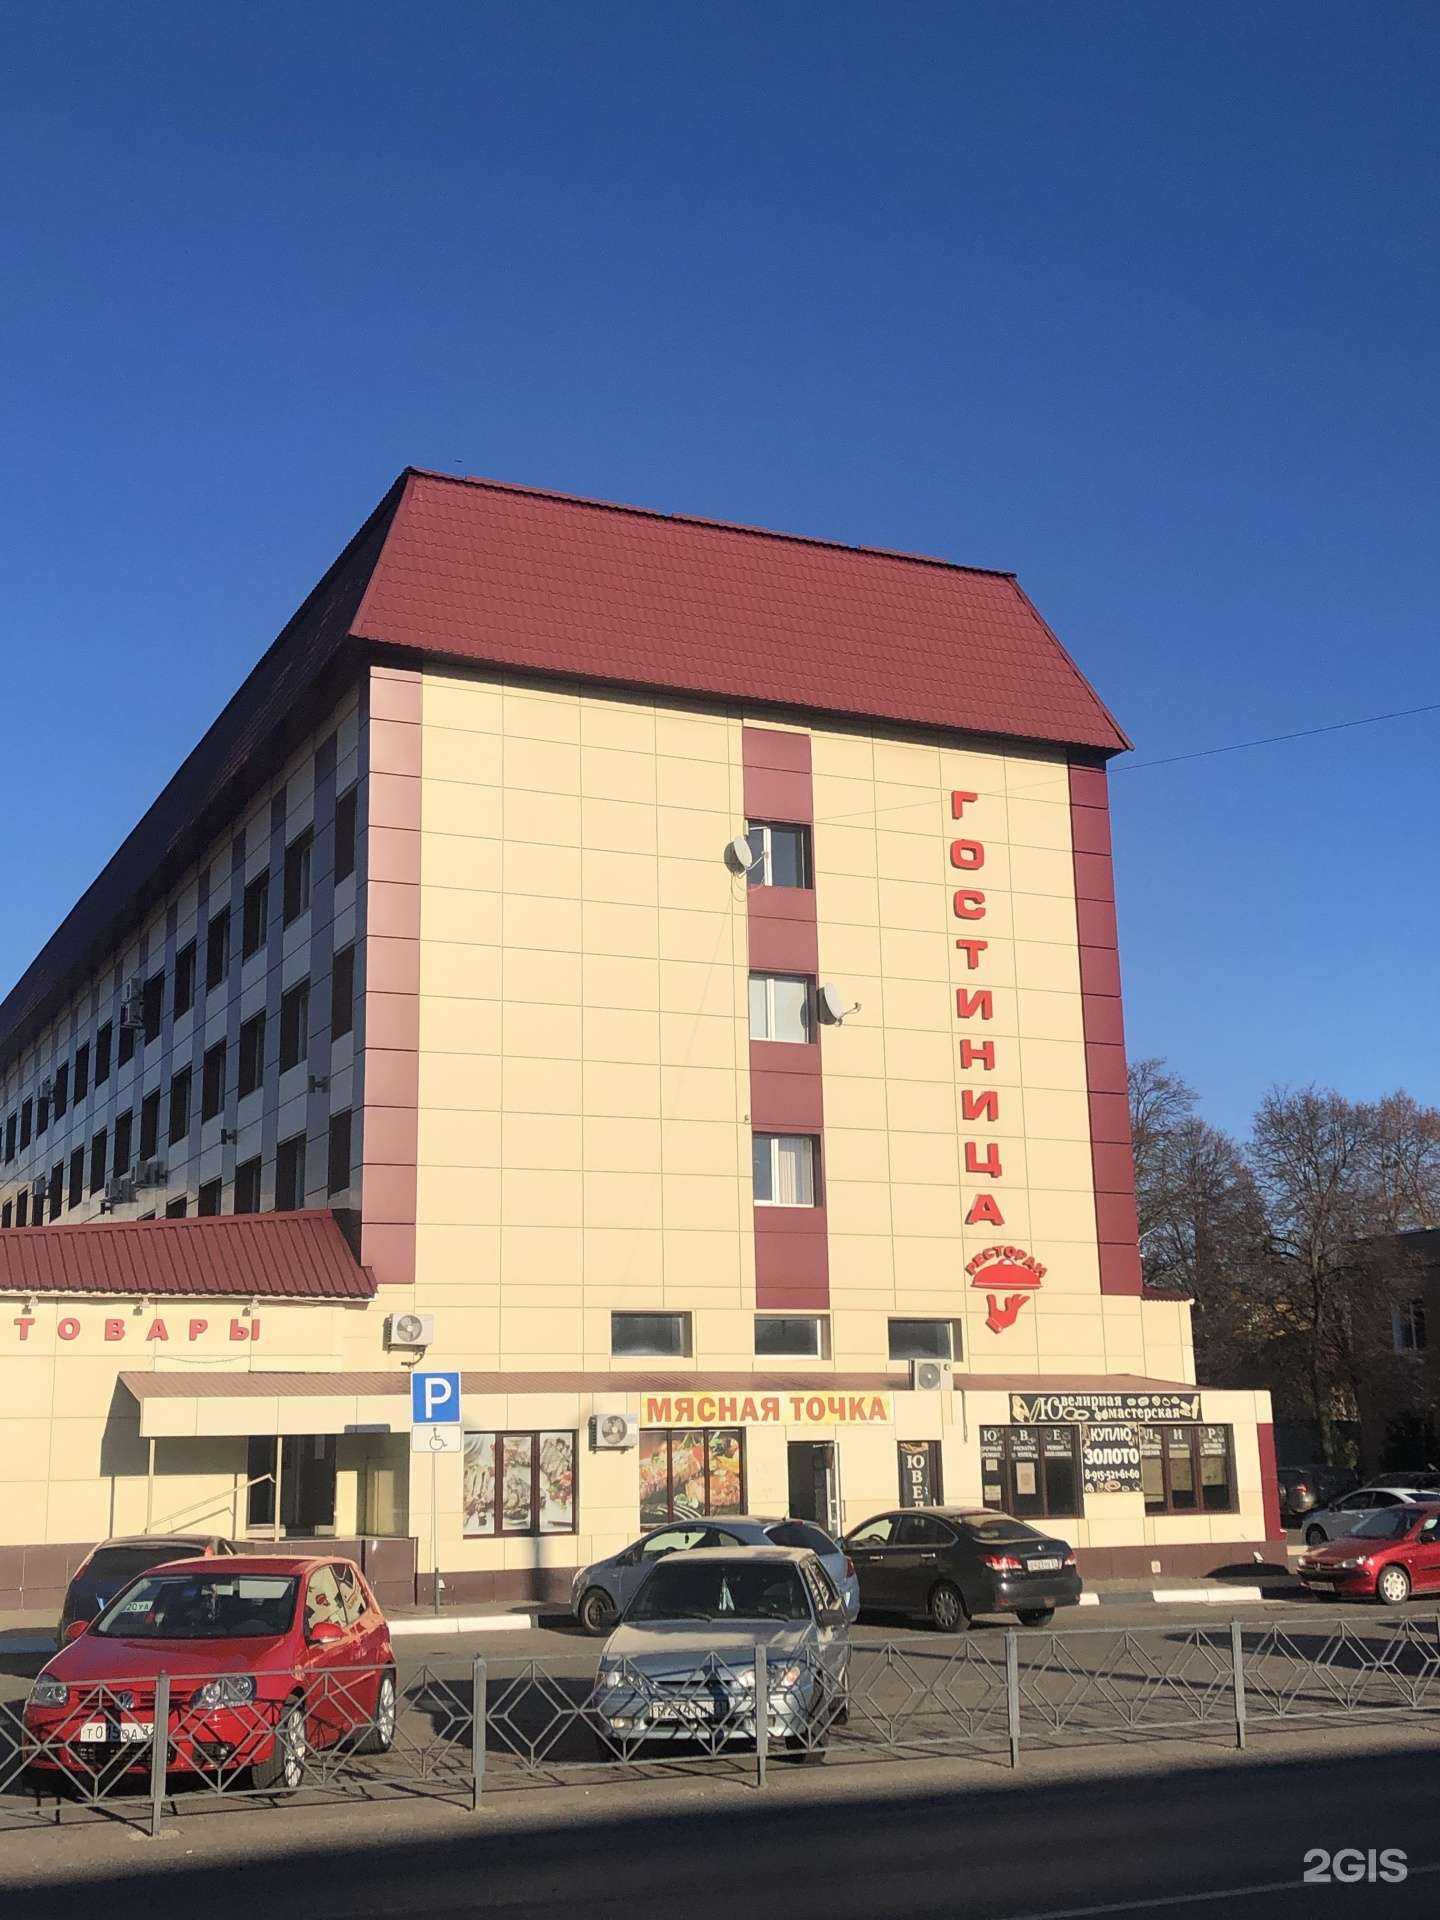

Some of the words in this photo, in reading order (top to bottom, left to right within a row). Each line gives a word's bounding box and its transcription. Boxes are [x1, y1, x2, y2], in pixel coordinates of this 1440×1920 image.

[950, 790, 1005, 1226] ГОСТИНИЦА
[965, 1245, 1047, 1278] РЕСТОРАН
[14, 1318, 260, 1341] ТОВАРЫ
[647, 1397, 780, 1422] МЯСНАЯ
[790, 1396, 887, 1421] ТОЧКА
[1039, 1396, 1122, 1420] Ювелирная
[1108, 1407, 1180, 1421] мастерская
[1090, 1427, 1132, 1441] КУПЛЮ
[1084, 1448, 1139, 1465] ЗОЛОТО
[1085, 1469, 1139, 1481] 8-915-521-61-60
